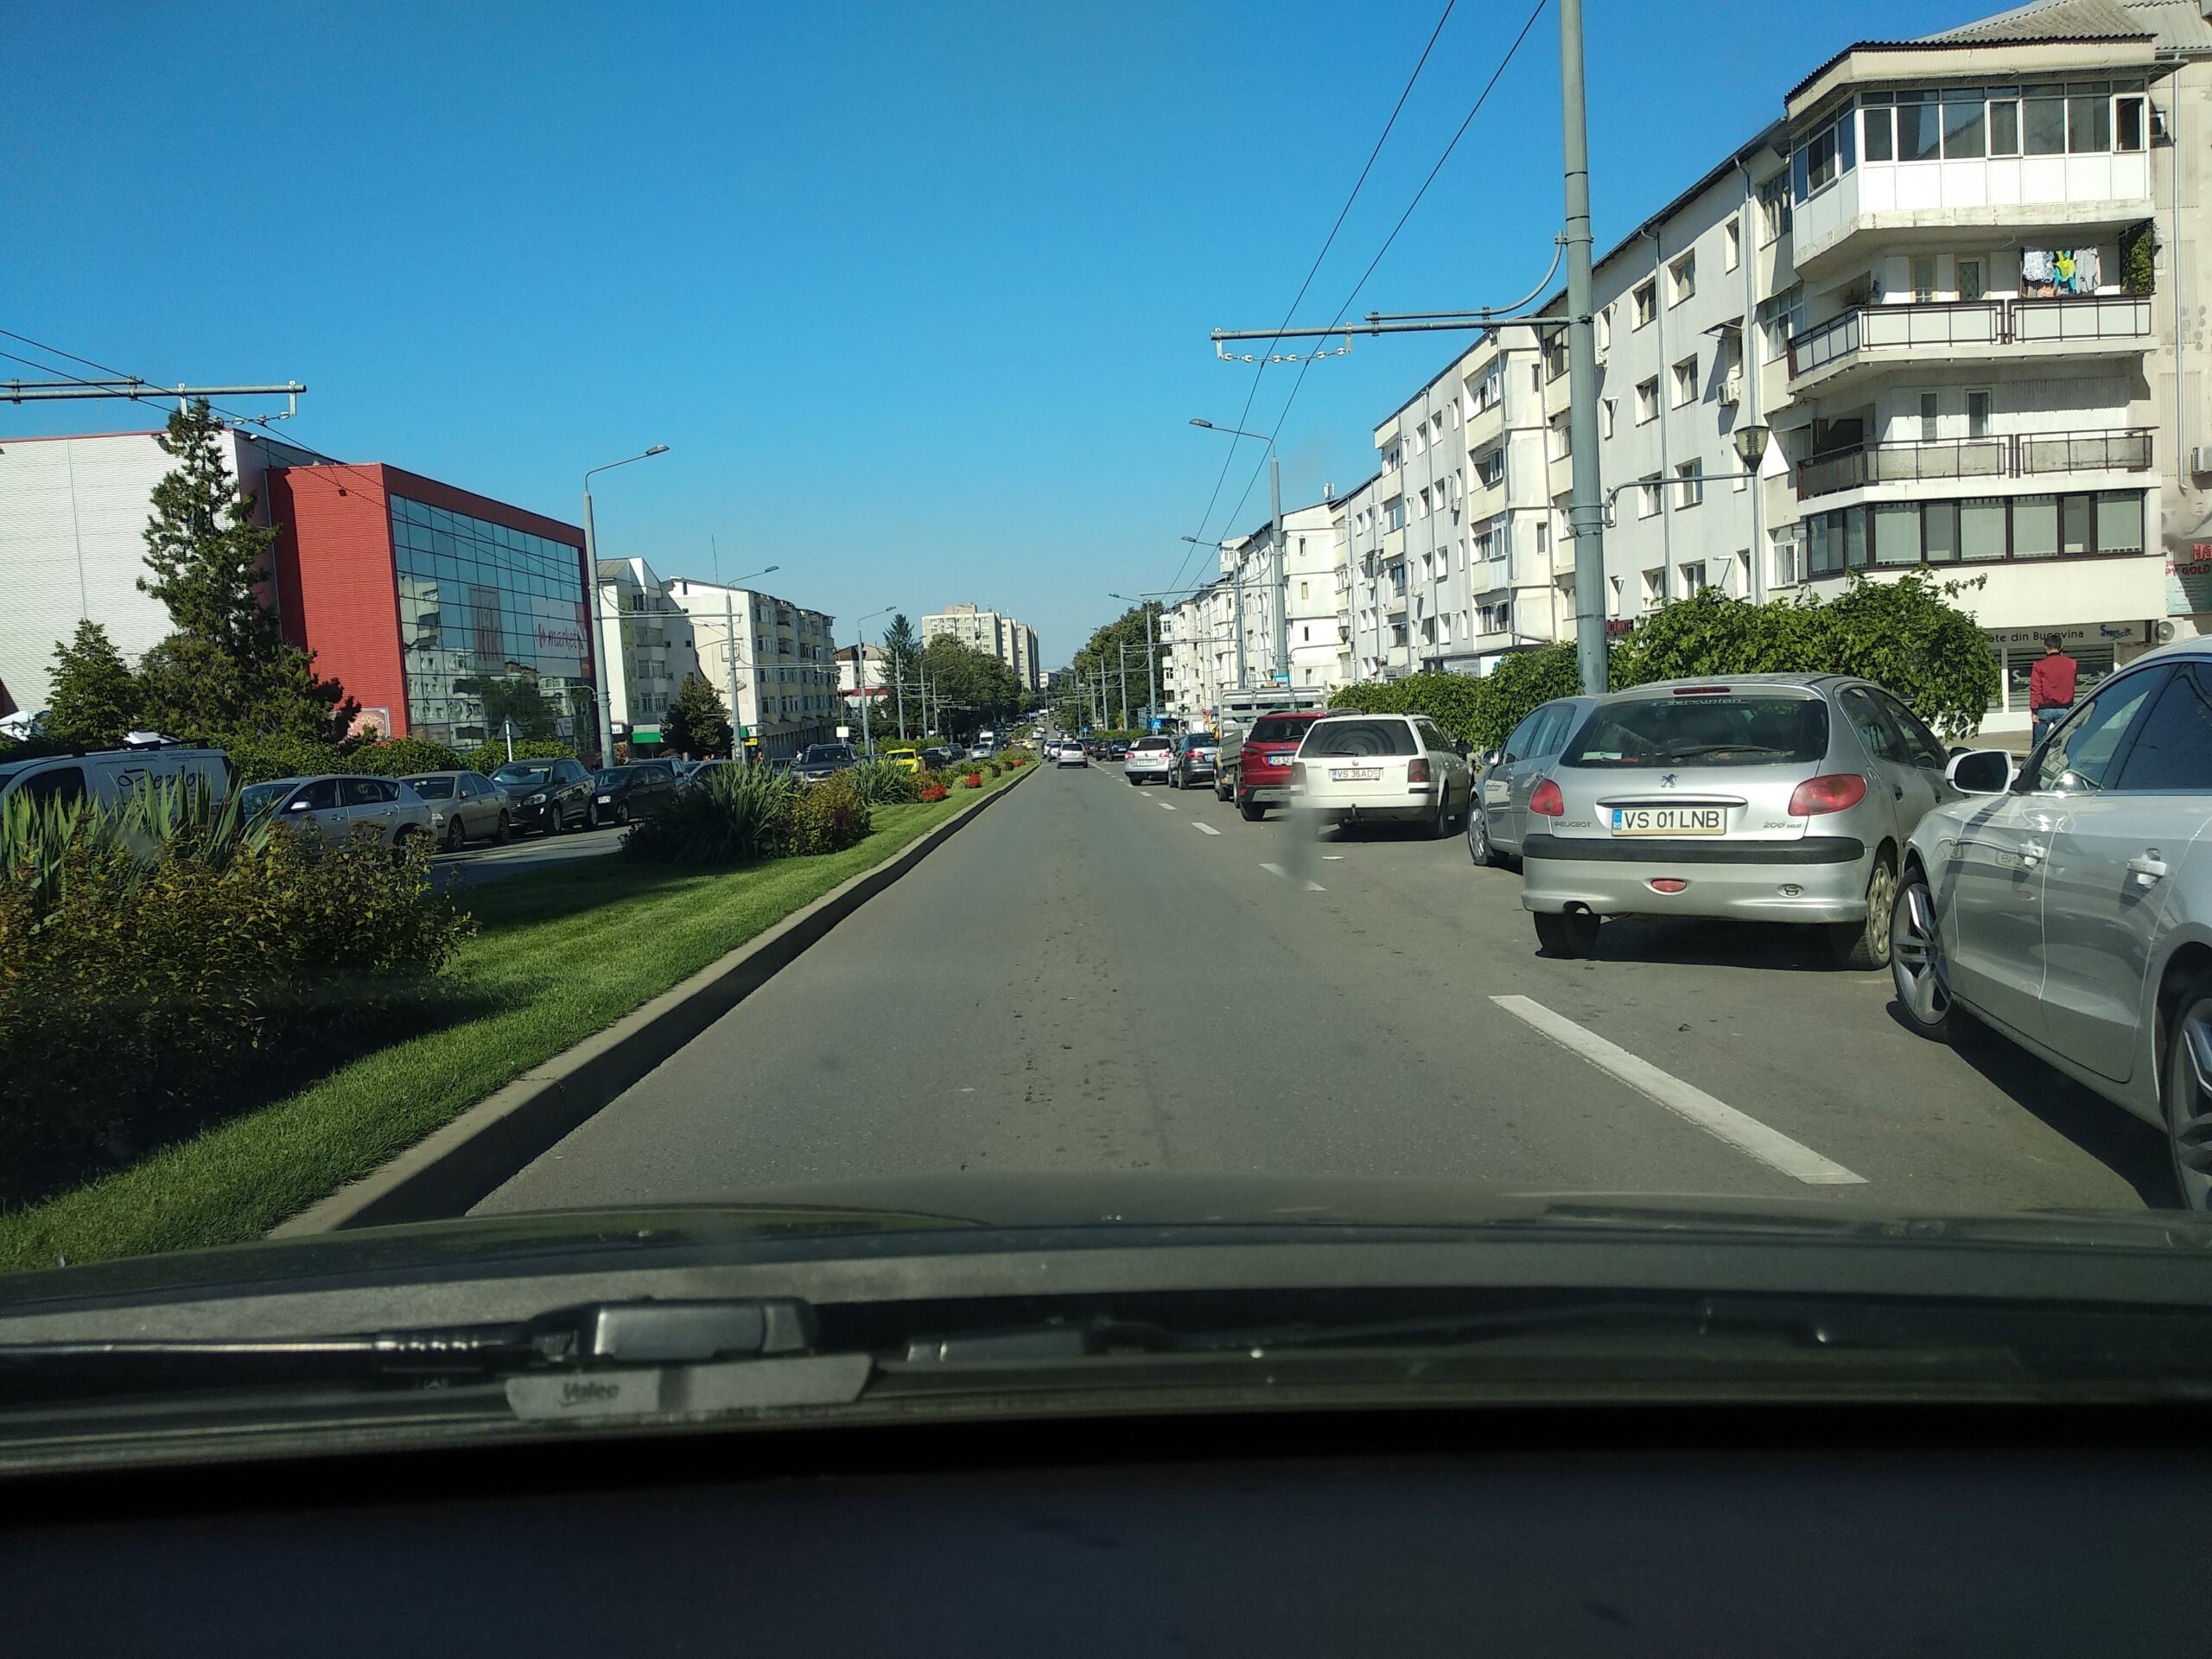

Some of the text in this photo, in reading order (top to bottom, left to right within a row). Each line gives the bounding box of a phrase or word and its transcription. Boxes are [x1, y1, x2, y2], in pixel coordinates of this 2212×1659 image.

[2182, 563, 2210, 575] GOLD
[548, 626, 577, 651] market
[2011, 632, 2029, 642] din
[1624, 811, 1650, 829] VS
[1656, 811, 1675, 829] 01
[1679, 810, 1720, 829] LNB
[563, 1381, 620, 1402] Valeo
